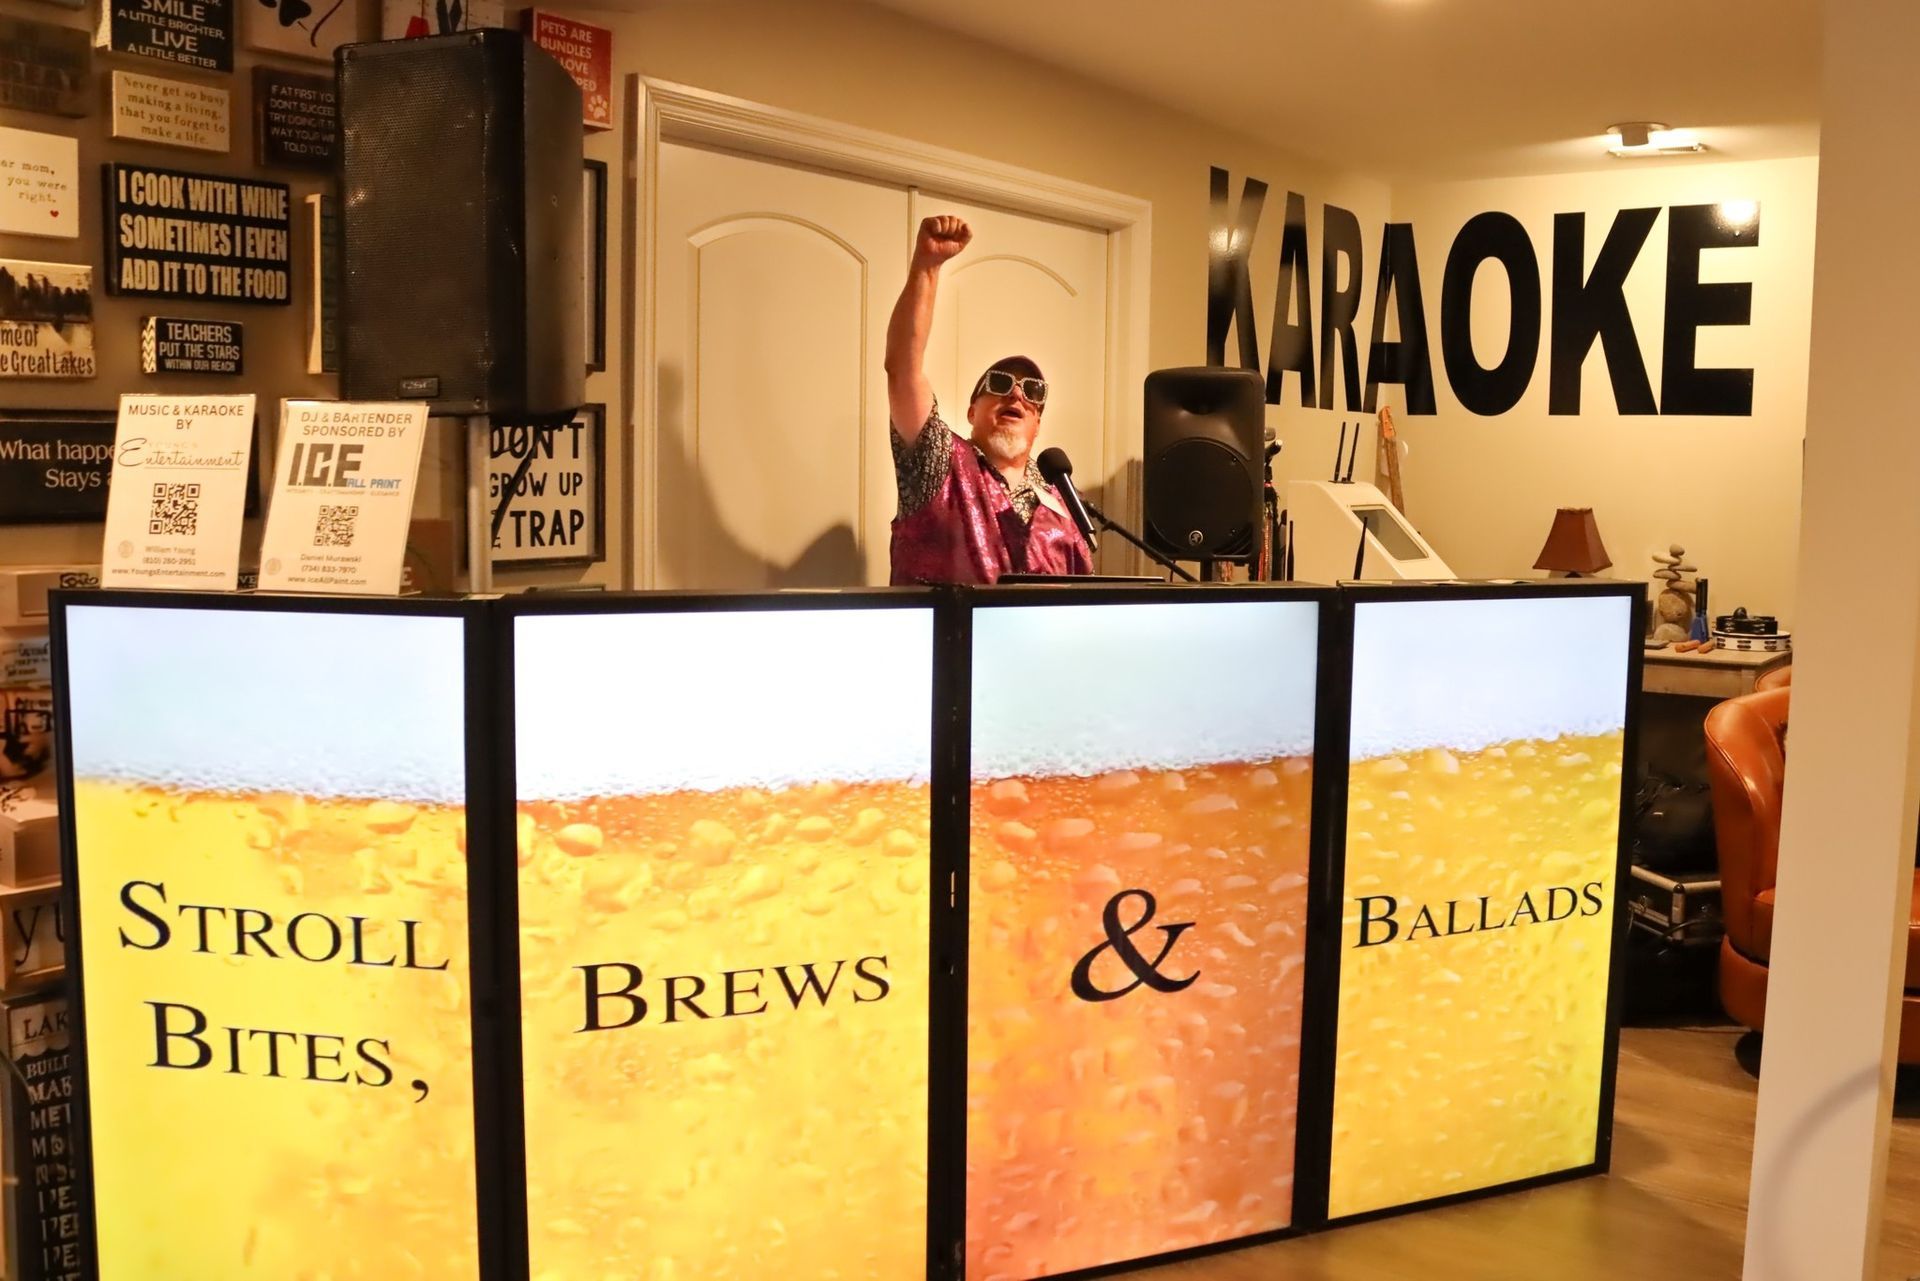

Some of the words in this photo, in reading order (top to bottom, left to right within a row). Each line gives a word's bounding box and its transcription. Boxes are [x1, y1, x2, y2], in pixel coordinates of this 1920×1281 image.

[118, 8, 127, 18] A
[129, 10, 166, 27] LITTLE
[141, 0, 206, 22] SMILE
[151, 28, 198, 53] LIVE
[540, 20, 567, 37] PETS
[570, 27, 593, 43] ARE
[127, 43, 137, 53] A
[138, 45, 176, 61] LITTLE
[177, 53, 217, 69] BETTER
[540, 36, 592, 60] BUNDLES
[124, 76, 159, 91] Never
[162, 86, 181, 97] get
[185, 92, 197, 100] so
[294, 88, 319, 100] FIRST
[127, 93, 172, 112] making
[120, 106, 145, 120] that
[149, 113, 171, 124] you
[174, 114, 210, 131] forget
[214, 122, 226, 134] to
[141, 126, 173, 138] make
[175, 132, 182, 140] a
[271, 127, 293, 138] WAY
[283, 141, 308, 154] TOLD
[310, 144, 329, 157] YOU
[7, 176, 31, 187] you
[38, 181, 67, 191] were
[119, 169, 127, 203] I
[131, 171, 185, 210] COOK
[188, 178, 238, 216] WITH
[240, 185, 288, 221] WINE
[120, 213, 231, 257] SOMETIMES
[235, 225, 242, 258] I
[245, 226, 288, 262] EVEN
[121, 257, 160, 292] ADD
[163, 261, 181, 293] IT
[184, 263, 207, 295] TO
[210, 265, 242, 298] THE
[245, 268, 287, 300] FOOD
[1204, 164, 1761, 417] KARAOKE
[24, 323, 39, 347] of
[166, 322, 232, 343] TEACHERS
[159, 341, 180, 357] PUT
[183, 343, 205, 358] THE
[206, 345, 240, 360] STARS
[11, 350, 51, 375] Great
[52, 350, 94, 375] Lakes
[164, 358, 192, 370] WITHIN
[211, 361, 236, 372] REACH
[128, 404, 170, 416] MUSIC
[172, 405, 180, 416] &
[183, 405, 245, 417] KARAOKE
[301, 412, 318, 423] DJ
[322, 413, 329, 423] &
[333, 413, 413, 425] BARTENDER
[175, 419, 193, 430] BY
[303, 425, 385, 437] SPONSORED
[388, 428, 406, 438] BY
[0, 439, 51, 460] What
[117, 437, 245, 467] Entertainment
[45, 468, 102, 492] Stays
[559, 472, 583, 496] UP
[509, 509, 585, 548] TRAP
[1070, 888, 1201, 1003] &
